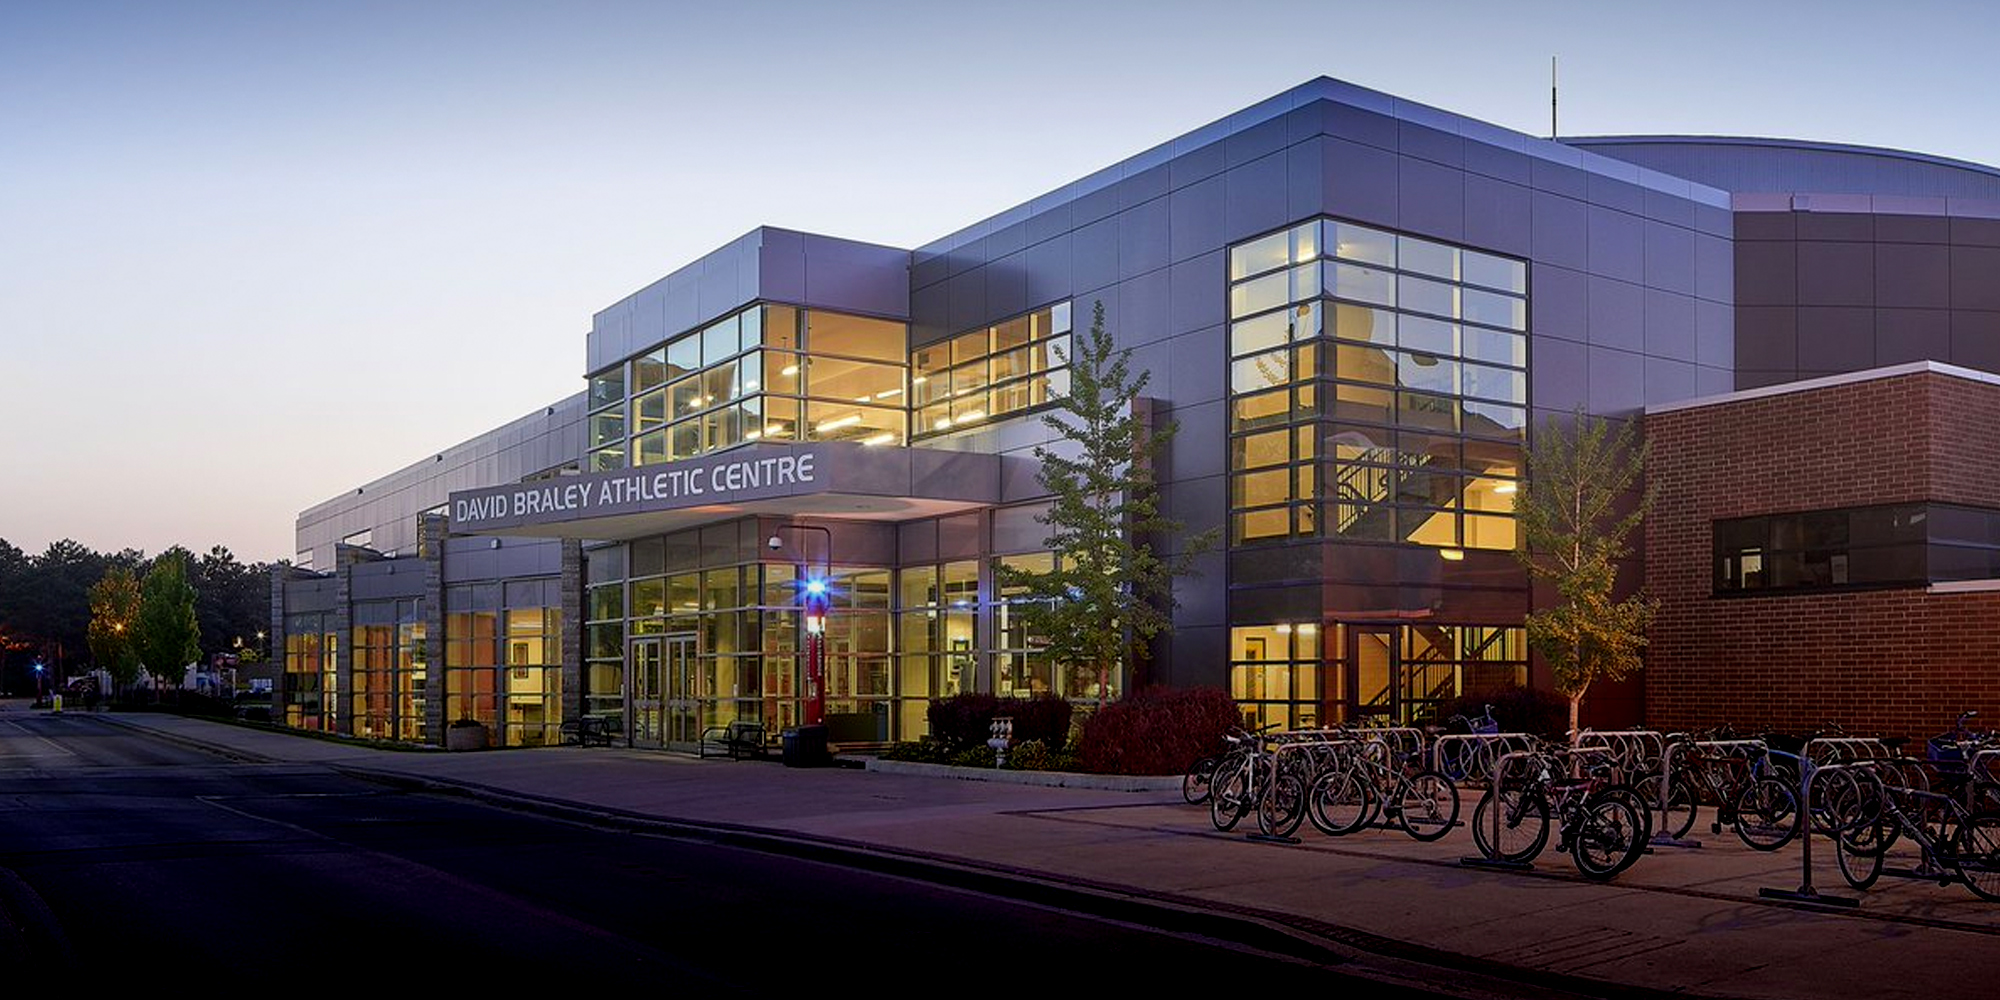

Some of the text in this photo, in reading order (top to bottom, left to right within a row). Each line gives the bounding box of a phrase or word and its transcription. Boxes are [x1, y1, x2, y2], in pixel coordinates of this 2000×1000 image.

[457, 454, 814, 522] DAVID BRALEY ATHLETIC CENTRE
